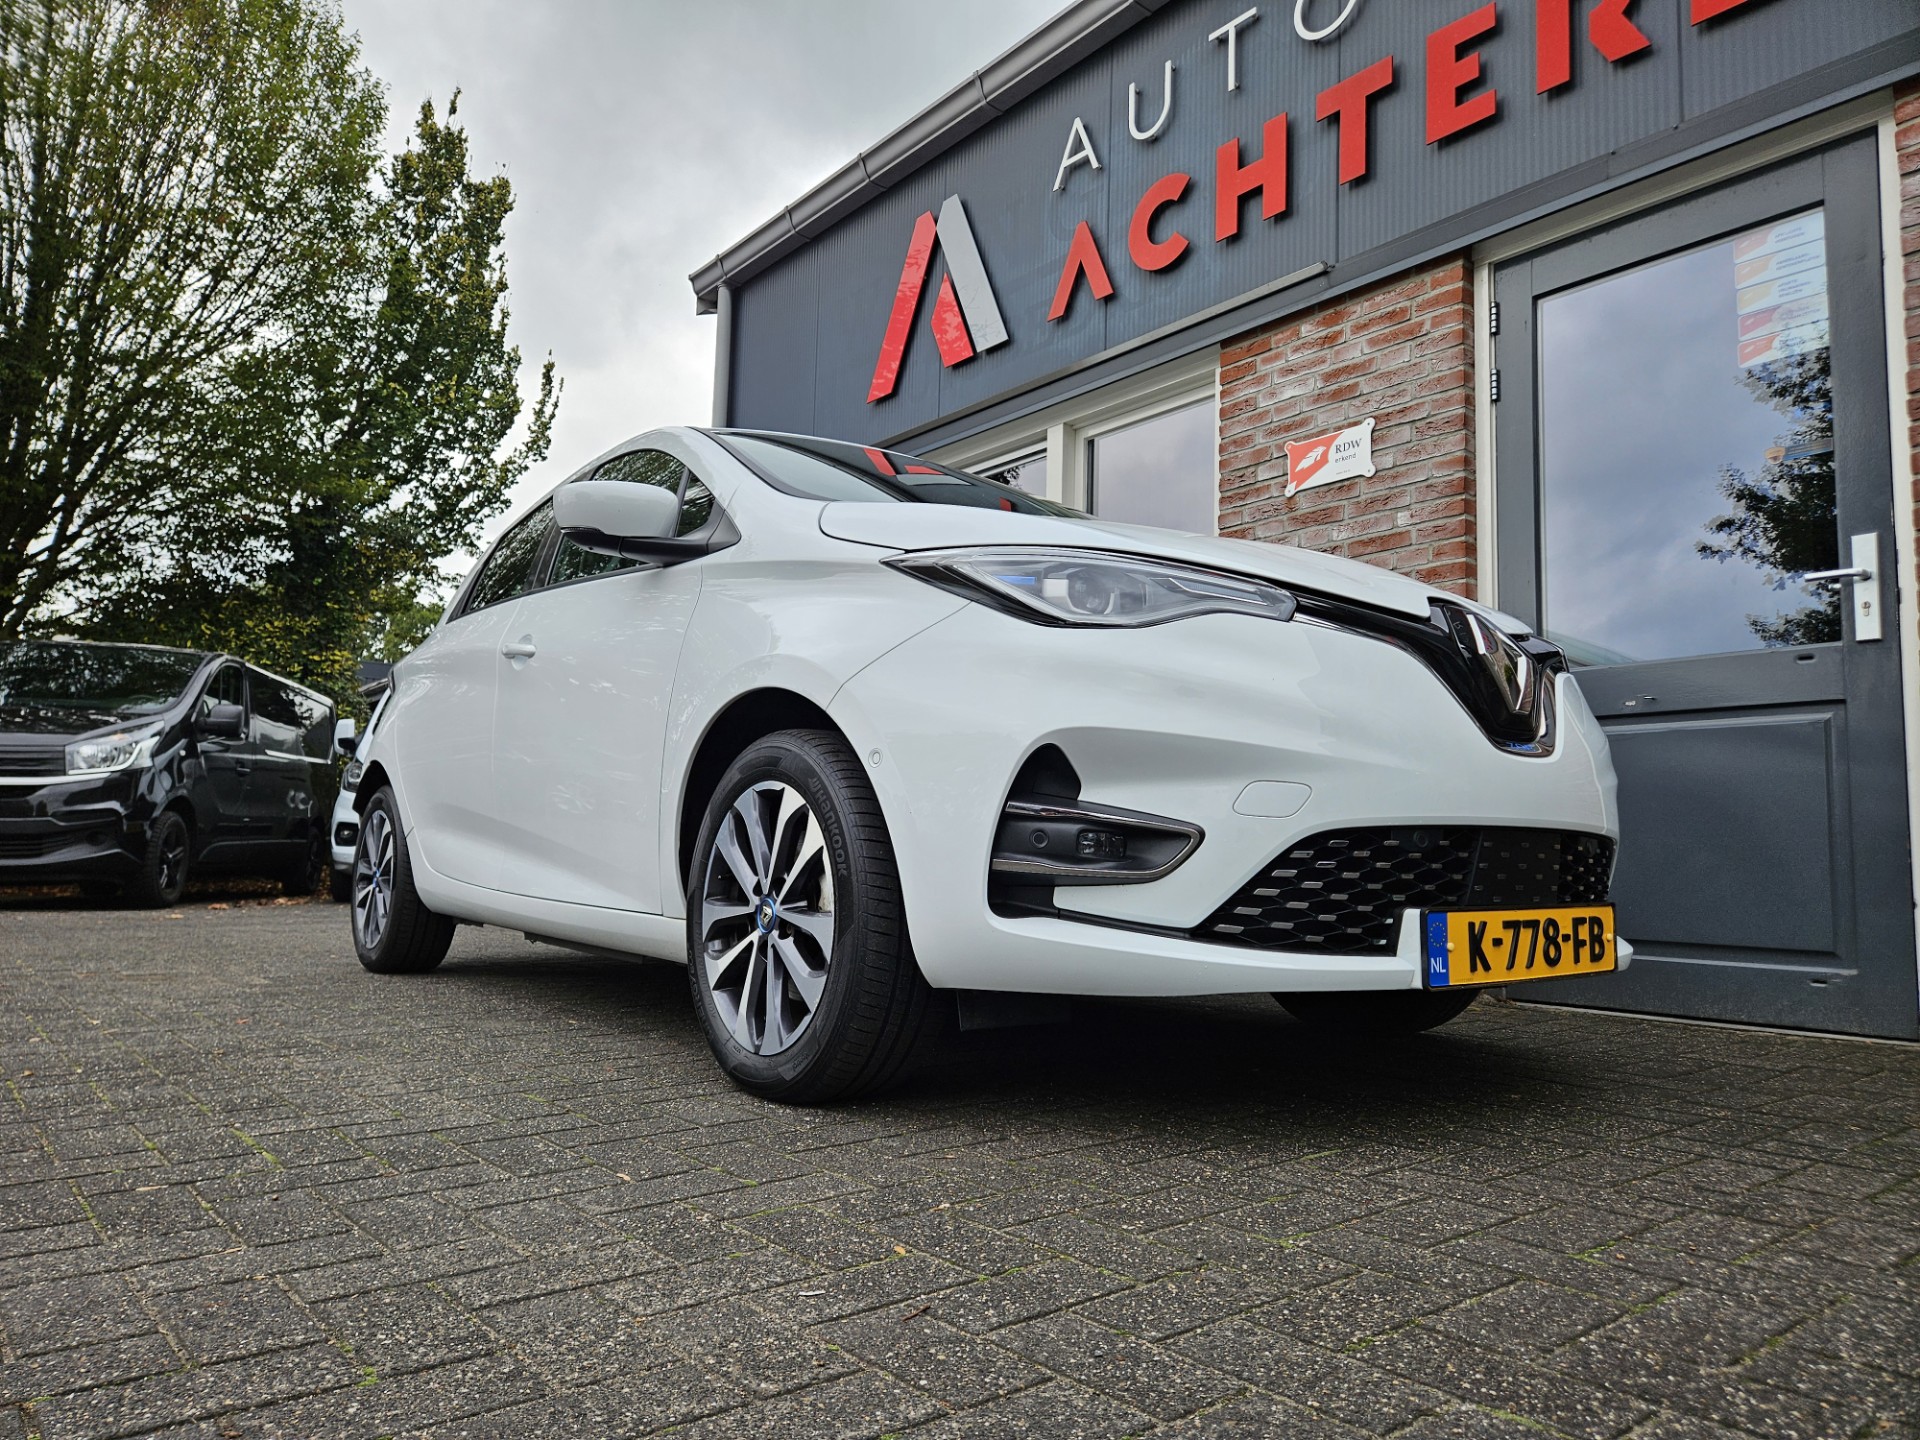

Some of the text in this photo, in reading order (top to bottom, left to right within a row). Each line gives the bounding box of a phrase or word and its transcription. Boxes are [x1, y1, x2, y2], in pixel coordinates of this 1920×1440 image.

[1047, 0, 1747, 321] ACHTER
[1335, 439, 1361, 453] RDW
[1335, 452, 1357, 463] erkend
[1468, 916, 1605, 973] K-778-FB
[1430, 957, 1446, 974] NL
